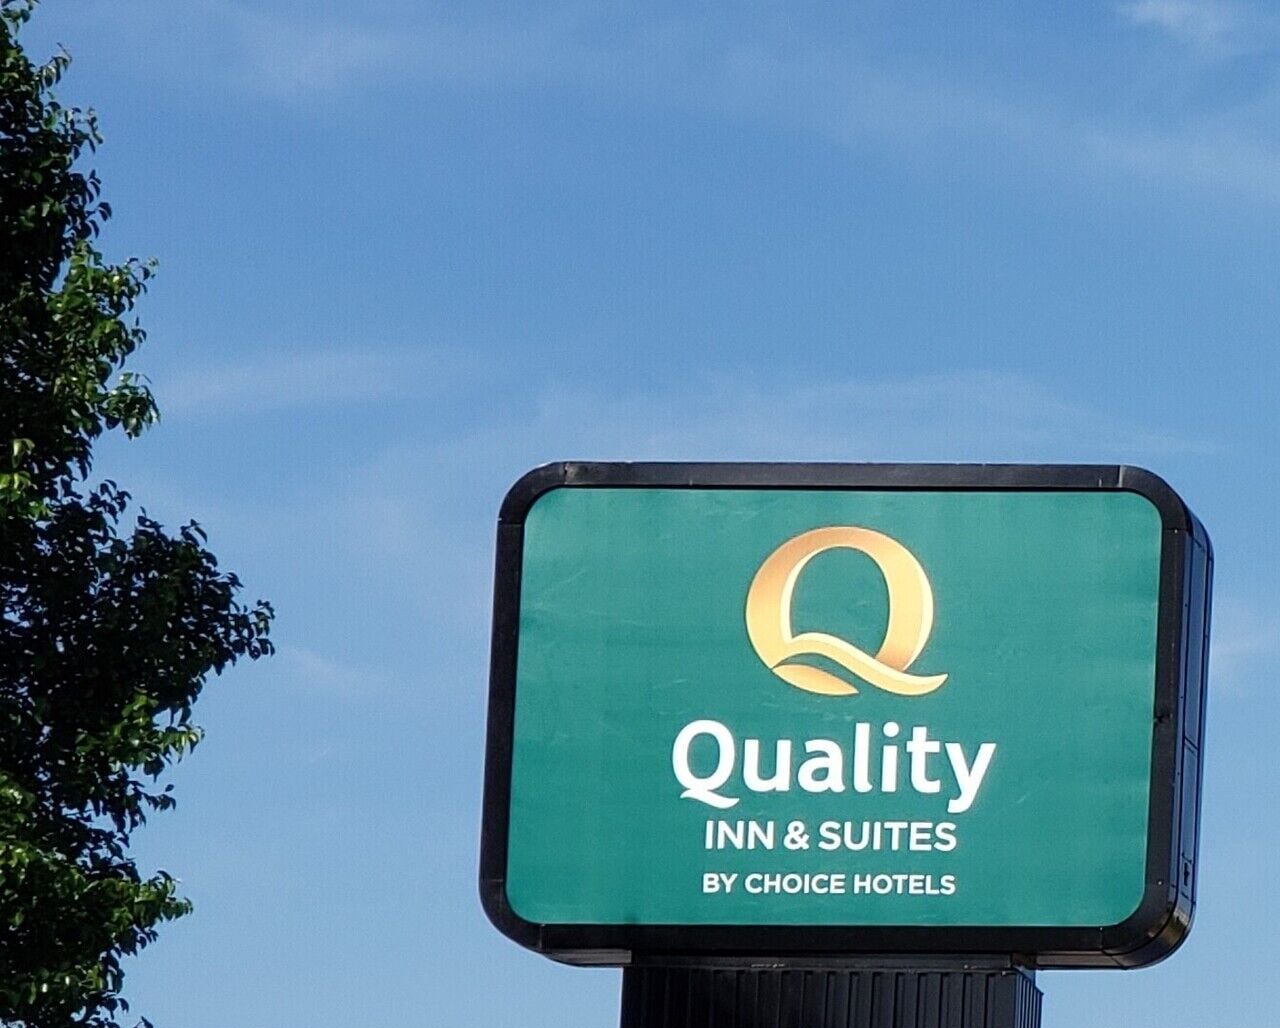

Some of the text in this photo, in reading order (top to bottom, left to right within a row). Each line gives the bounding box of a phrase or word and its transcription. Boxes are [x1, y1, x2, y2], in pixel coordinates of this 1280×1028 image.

[745, 526, 948, 696] Q
[672, 719, 996, 813] Quality
[704, 820, 957, 852] INN & SUITES
[702, 873, 956, 896] BY CHOICE HOTELS
